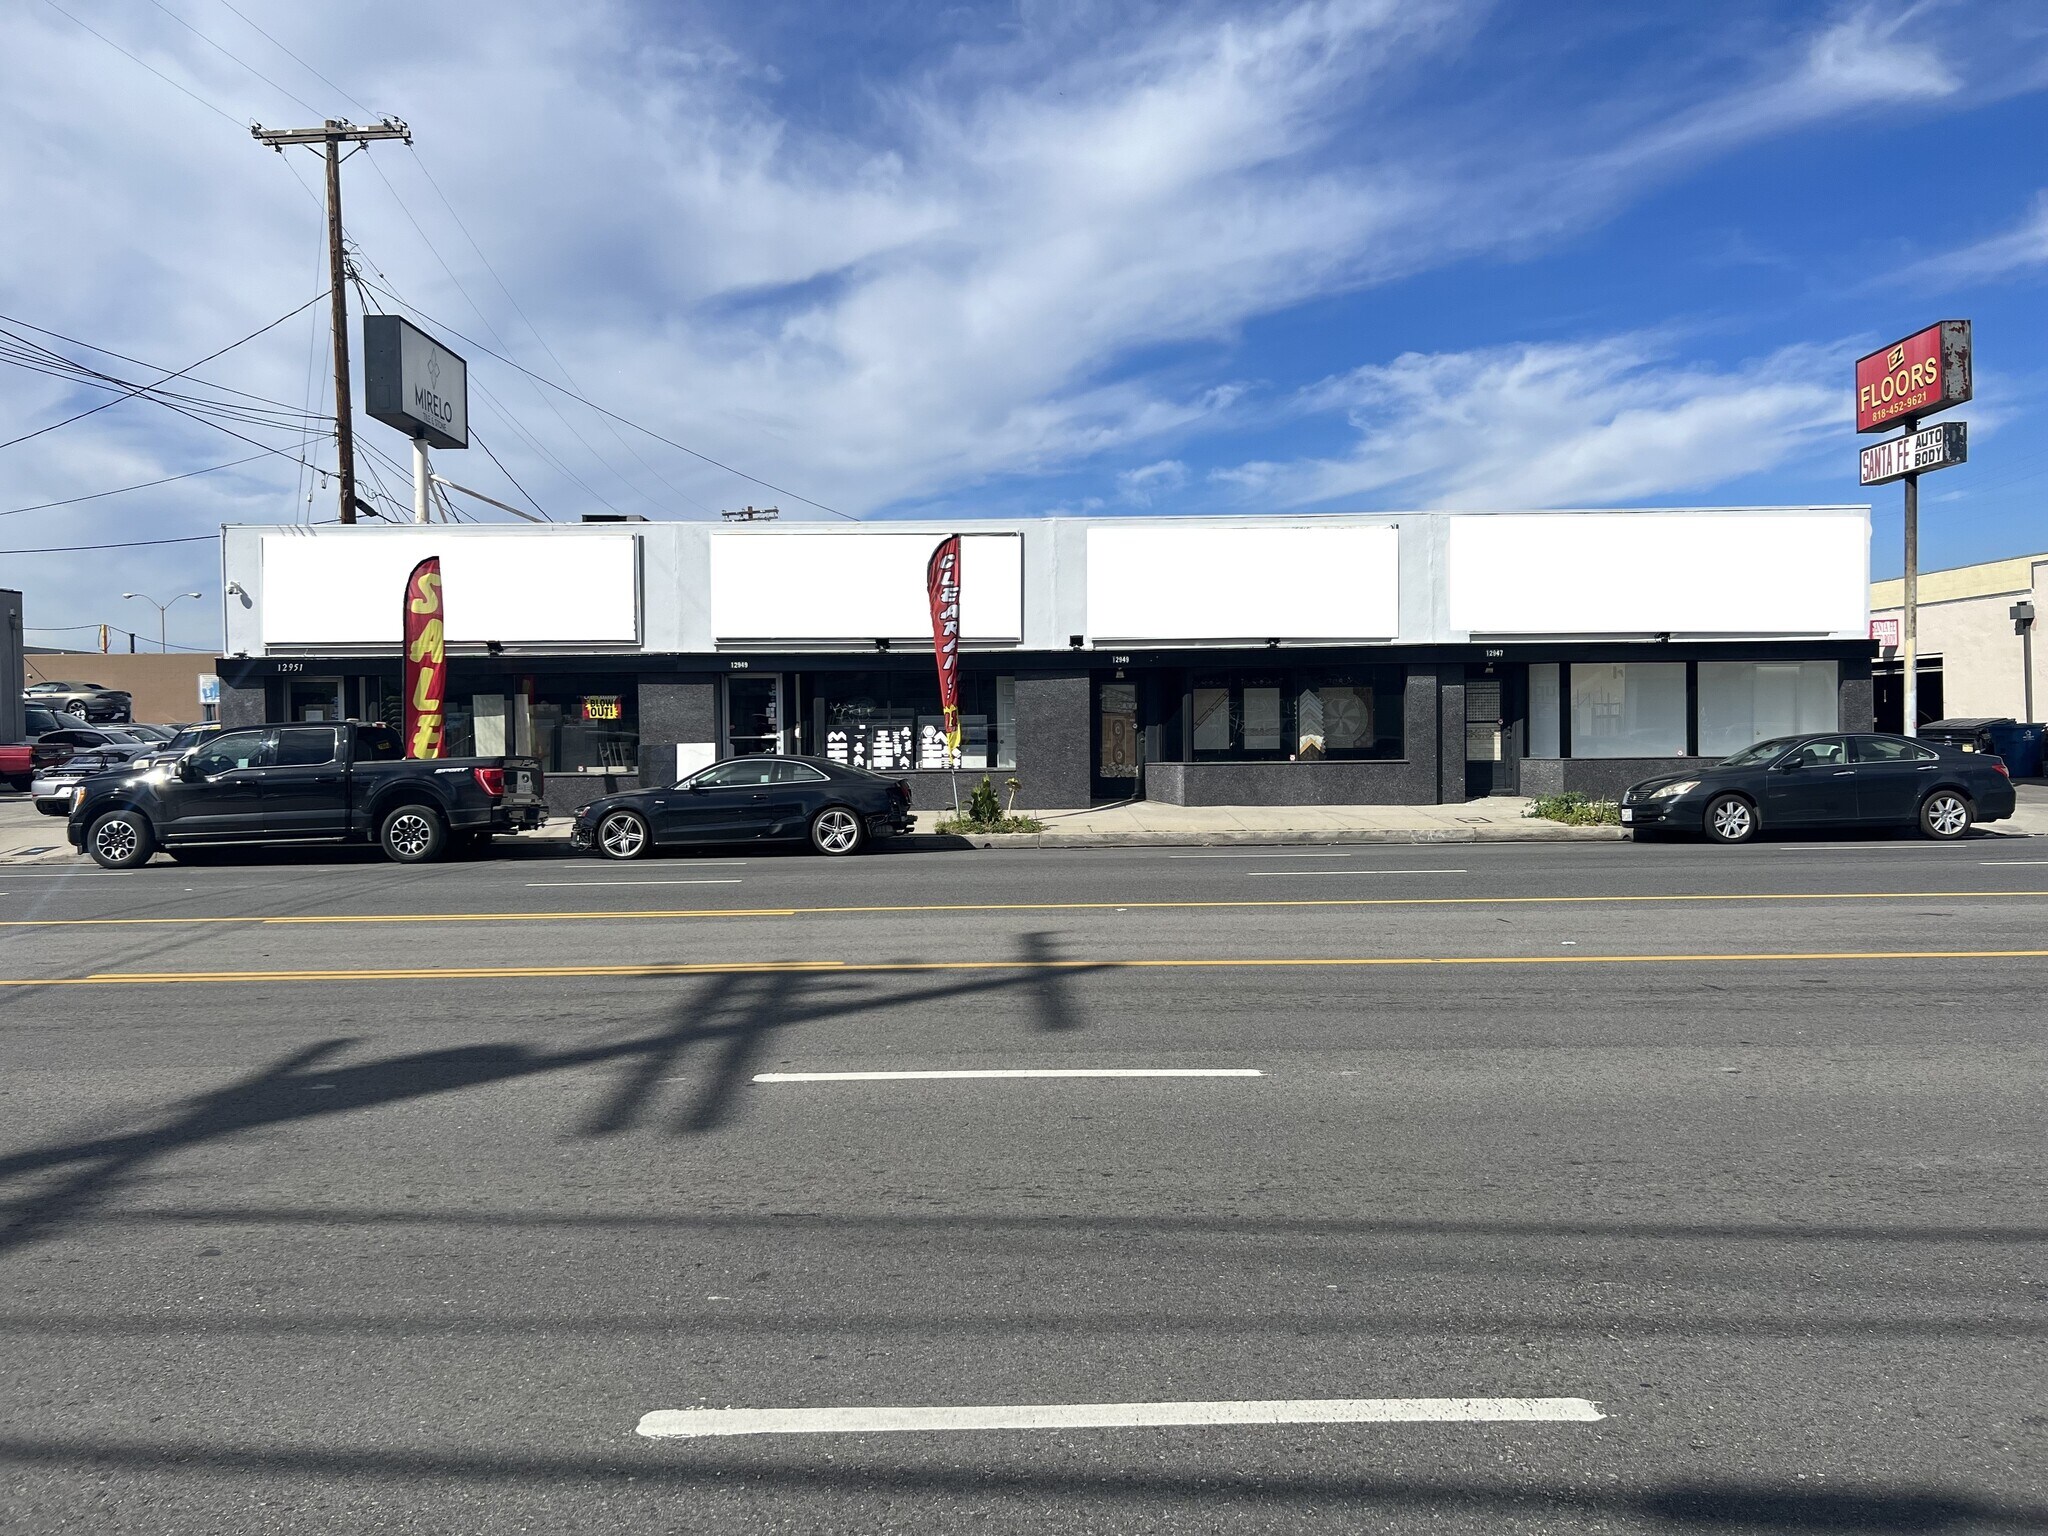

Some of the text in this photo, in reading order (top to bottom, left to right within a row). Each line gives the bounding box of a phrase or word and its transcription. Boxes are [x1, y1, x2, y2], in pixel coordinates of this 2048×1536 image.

[1889, 346, 1903, 368] EZ
[1860, 357, 1937, 412] FLOORS
[415, 383, 452, 423] MIRELO
[1872, 391, 1927, 422] 818-452-9621
[1915, 428, 1942, 450] AUTO
[1862, 439, 1910, 482] SANTA FE
[1915, 446, 1942, 468] BODY
[277, 663, 303, 672] 12951
[410, 573, 443, 760] SALE
[590, 699, 615, 707] BLOW
[590, 707, 614, 717] OUT!
